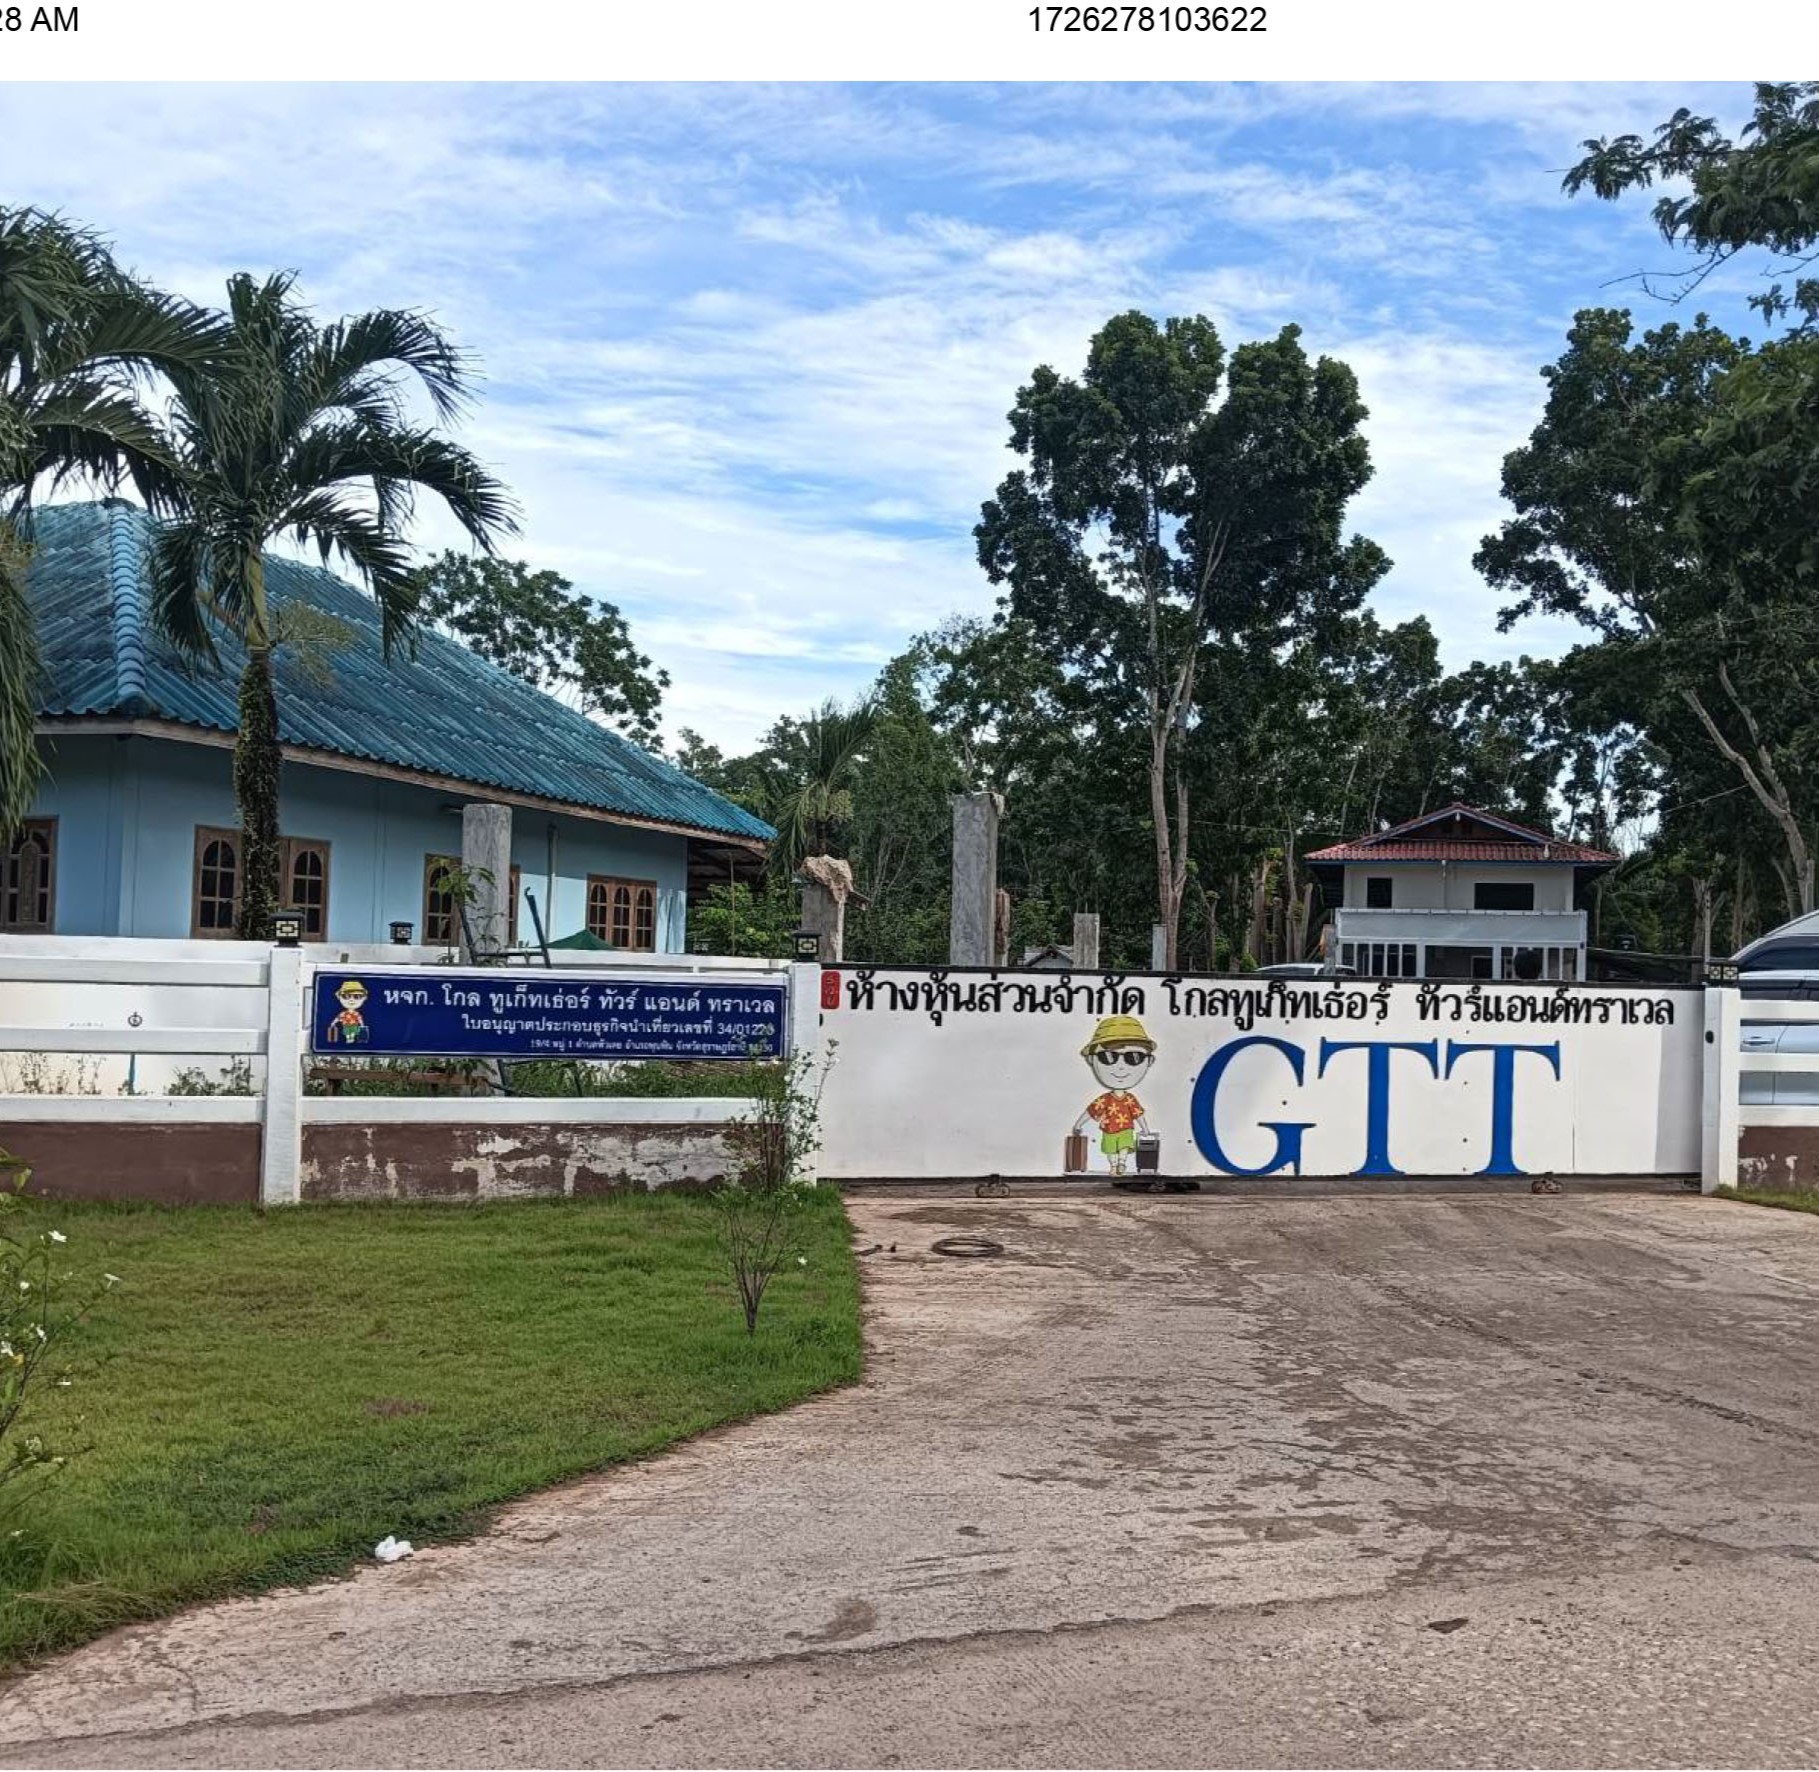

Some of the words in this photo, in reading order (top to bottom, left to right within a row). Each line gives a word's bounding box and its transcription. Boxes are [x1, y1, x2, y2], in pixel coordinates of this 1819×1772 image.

[383, 989, 435, 1006] หจก.
[441, 983, 481, 1007] โกล
[489, 984, 592, 1015] ทูเก็ทเธ่อร์
[598, 987, 640, 1010] ทัวร์
[644, 990, 702, 1012] แอนด์
[707, 997, 776, 1014] ทราเวล
[846, 970, 1145, 1027] ห้างหุ้นส่วนจำกัด
[1191, 1034, 1561, 1177] GTT
